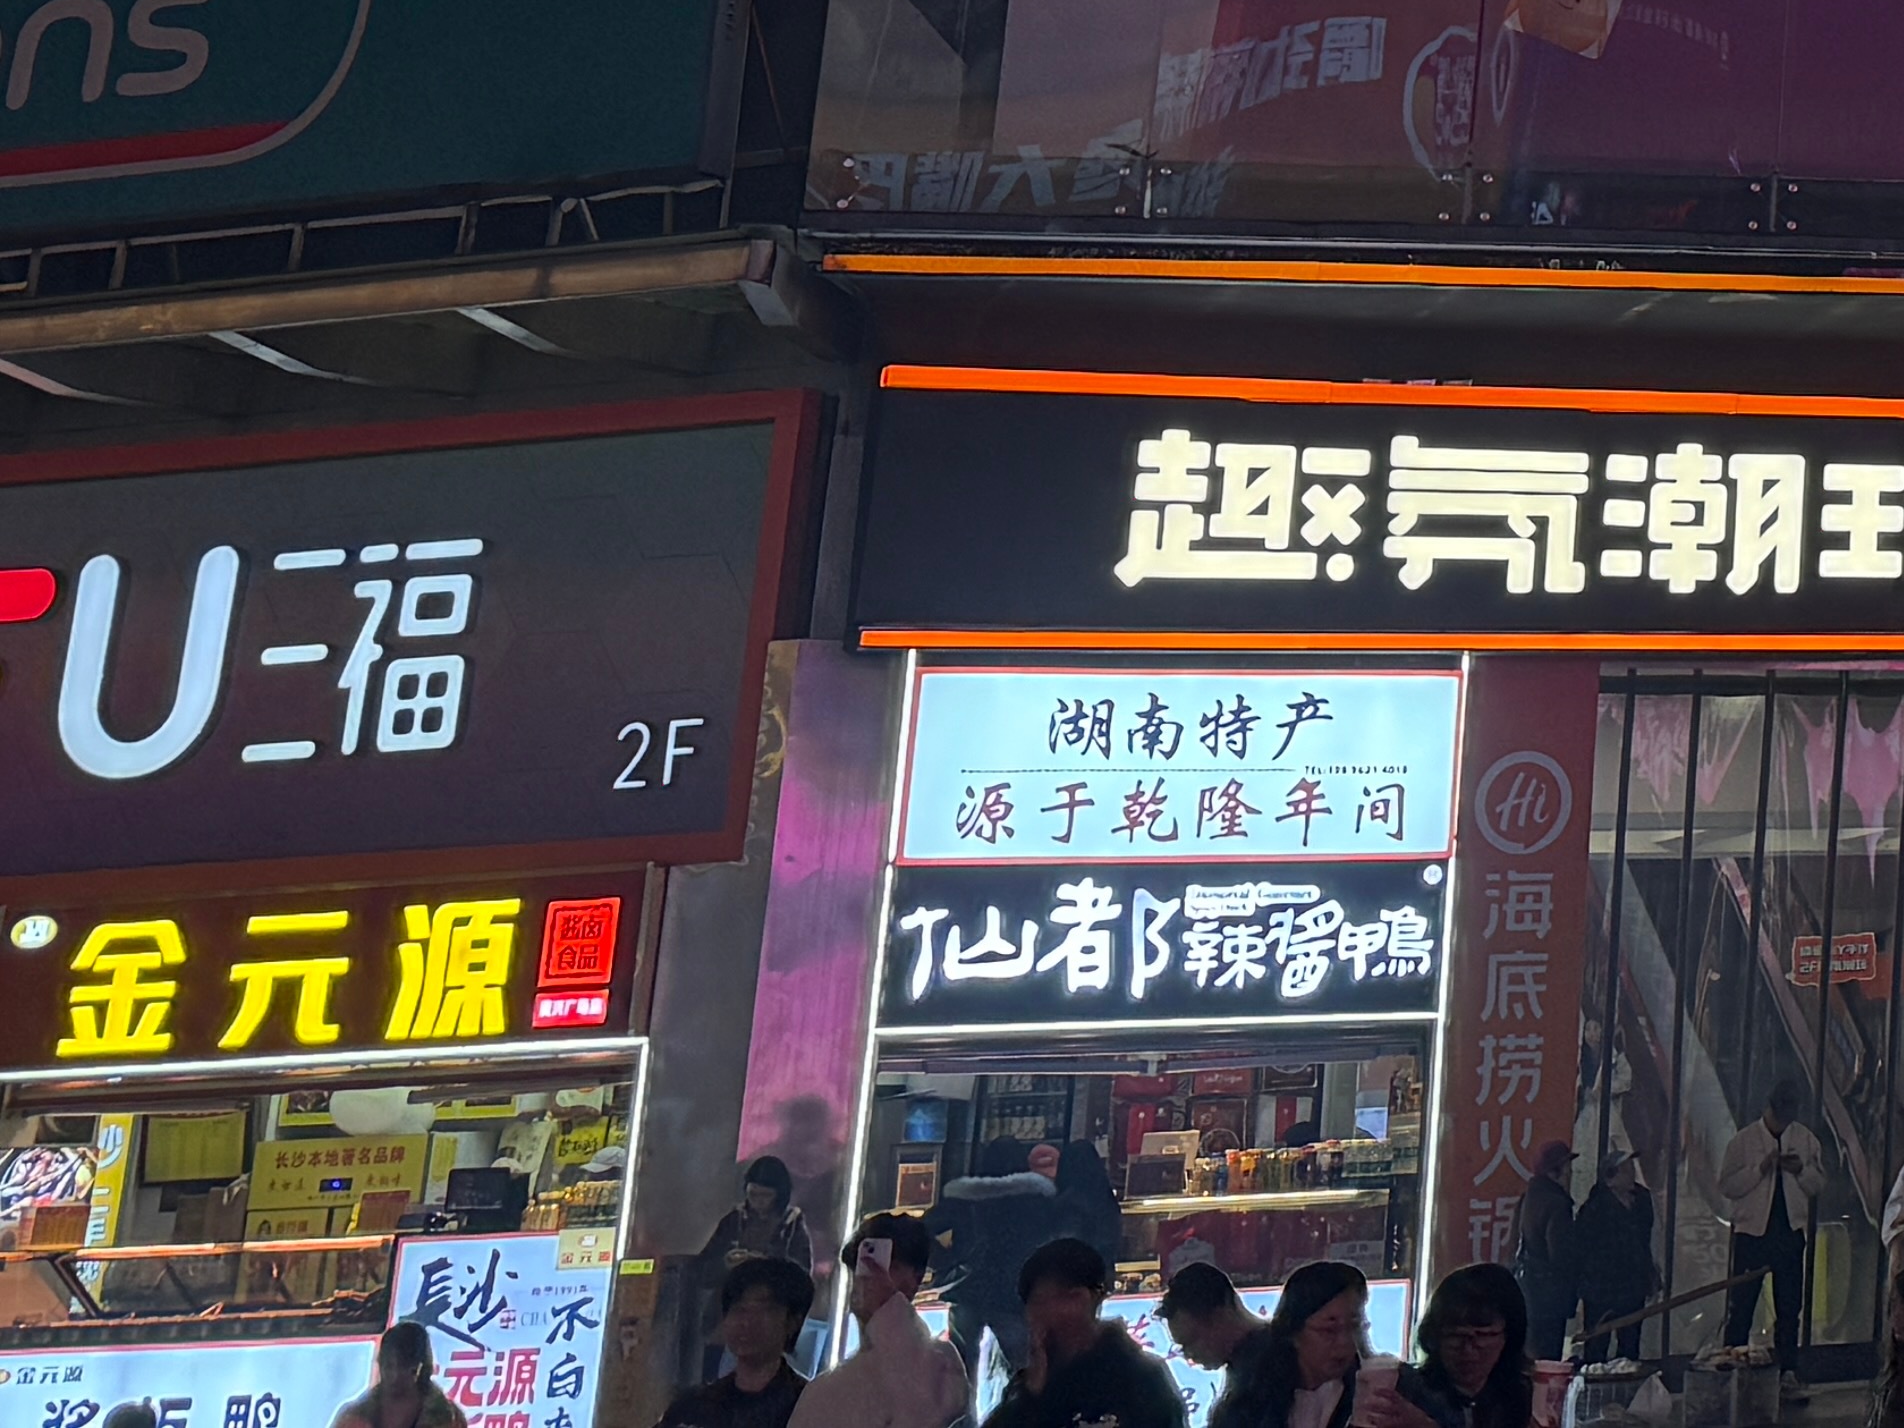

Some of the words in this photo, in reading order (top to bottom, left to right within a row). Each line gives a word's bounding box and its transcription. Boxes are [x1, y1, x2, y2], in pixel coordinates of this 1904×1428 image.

[612, 716, 704, 790] 2F
[1047, 691, 1335, 761] 湖南特产
[955, 775, 1406, 847] 源于乾隆年间
[54, 898, 522, 1058] 金元源
[557, 943, 600, 971] 食品
[433, 1347, 541, 1407] 元源
